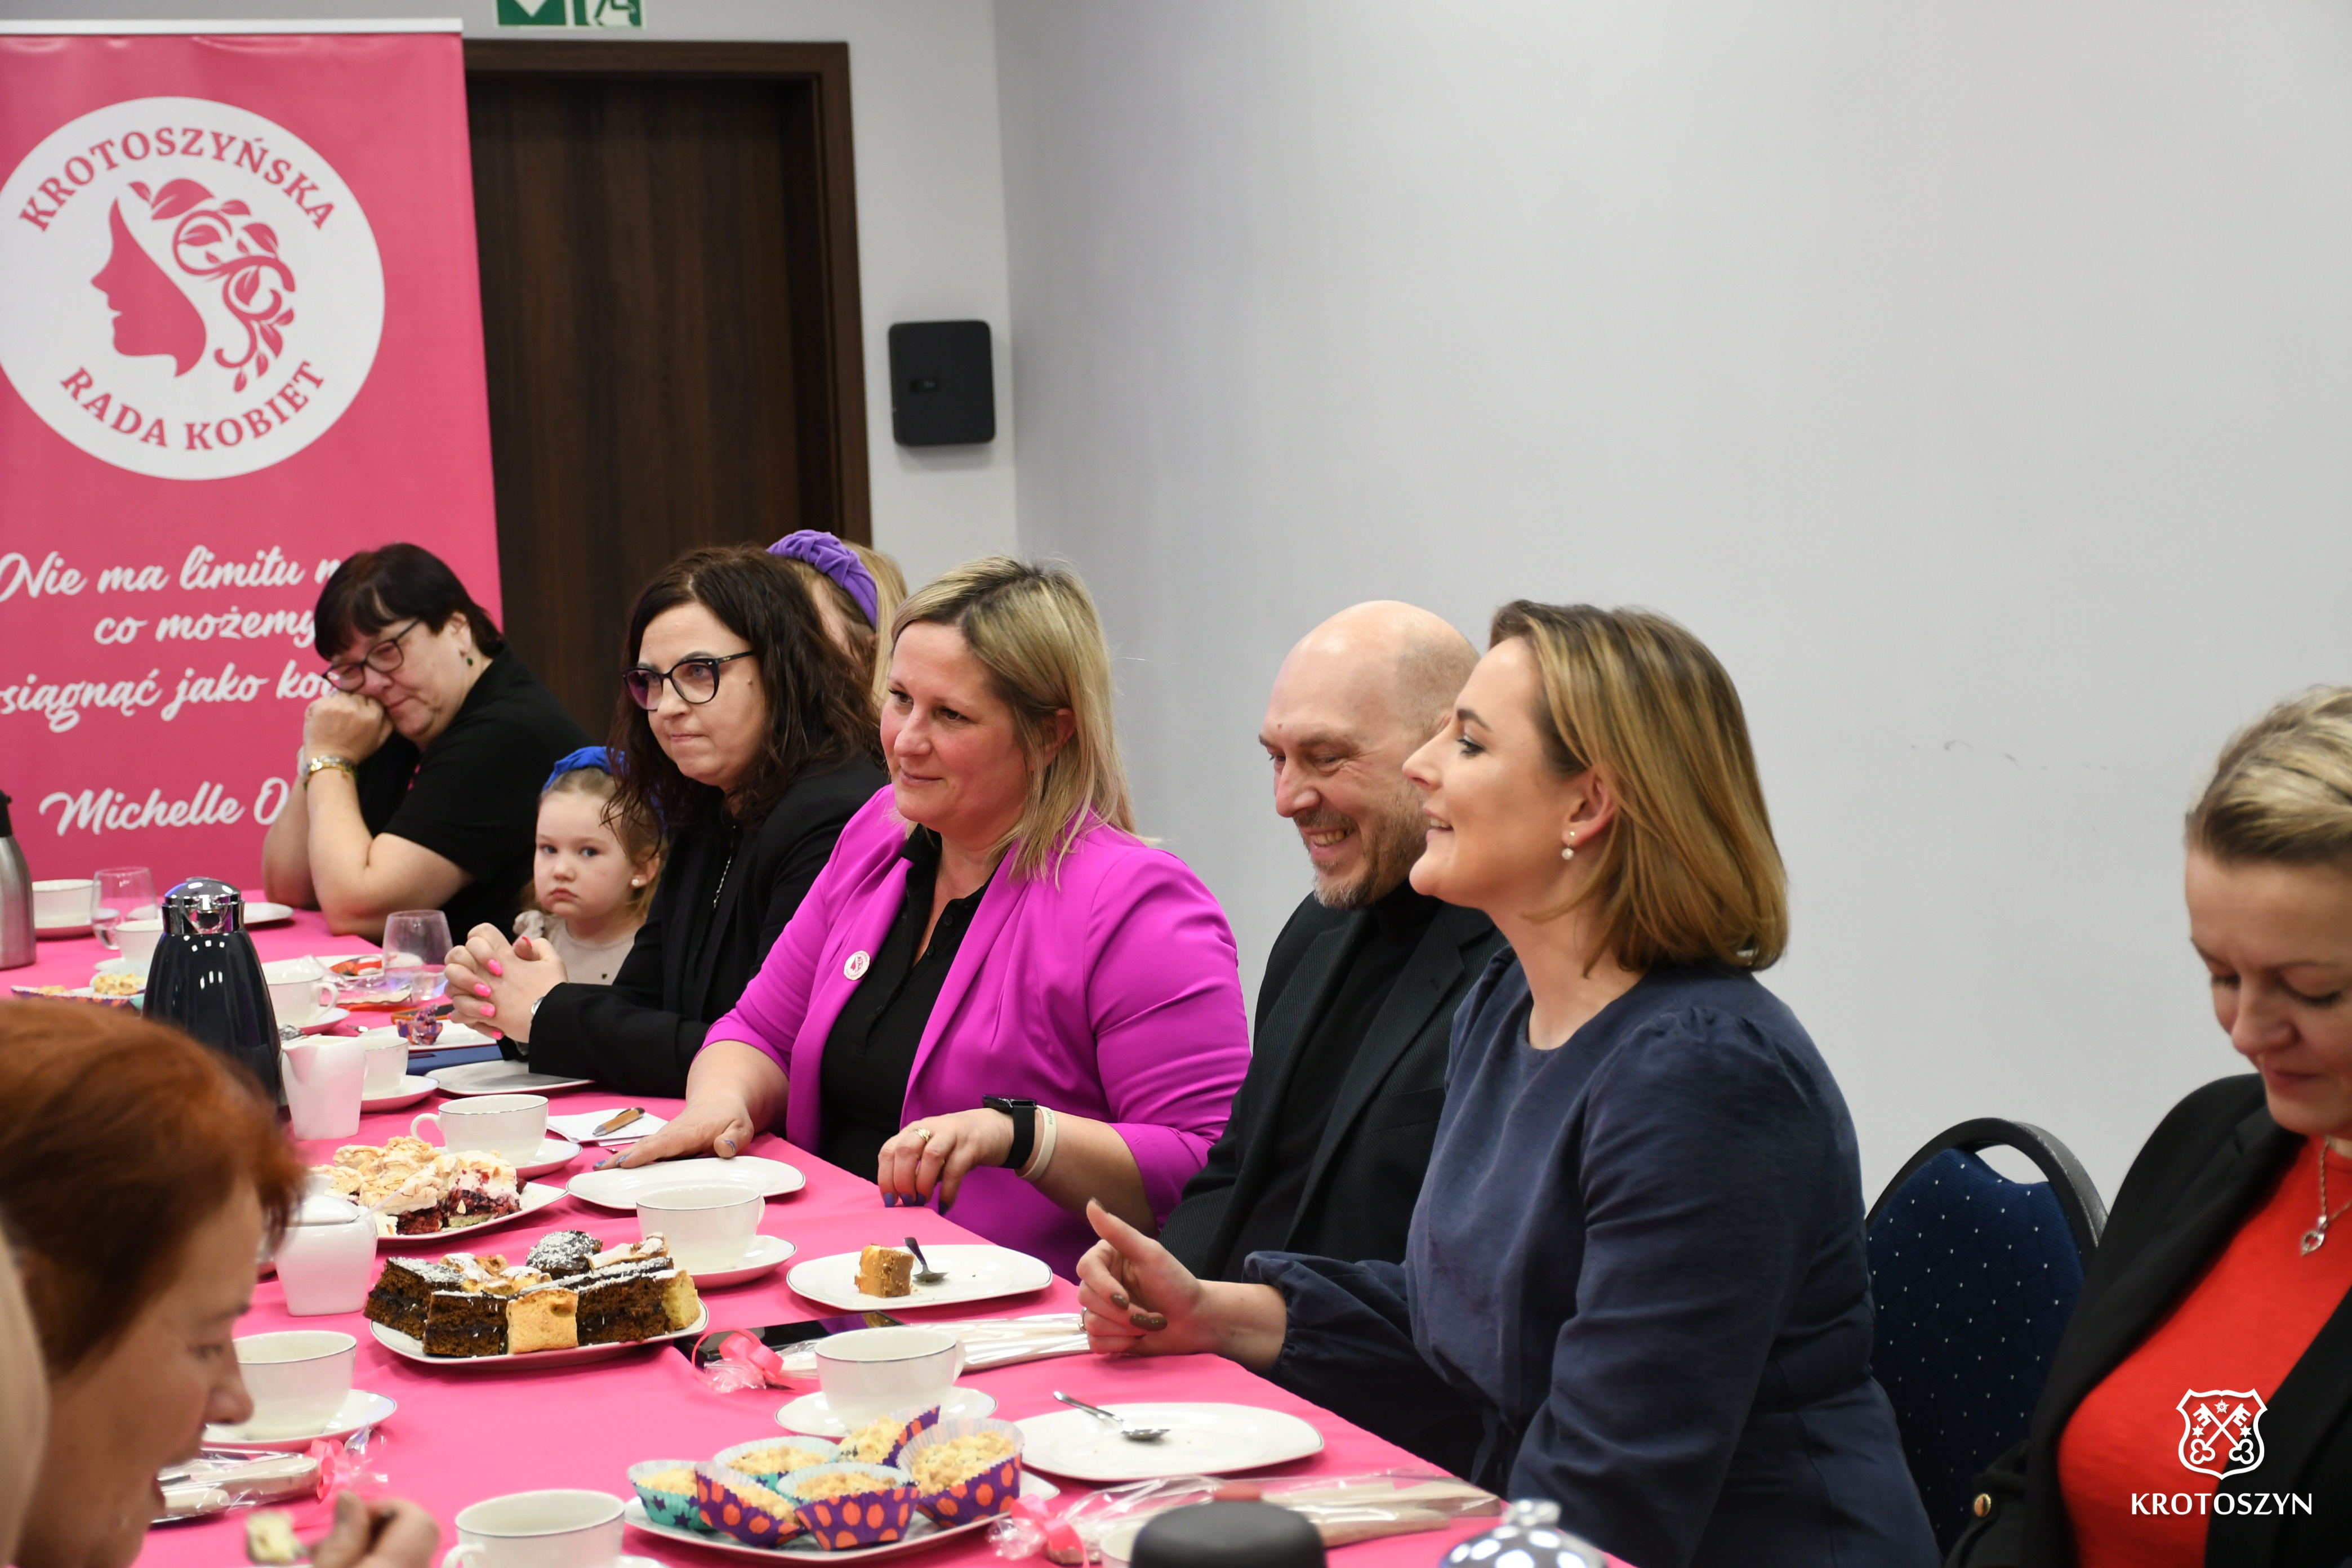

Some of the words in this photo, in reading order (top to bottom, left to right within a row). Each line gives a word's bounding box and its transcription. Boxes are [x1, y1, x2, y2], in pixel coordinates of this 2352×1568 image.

[19, 127, 335, 232] KROTOSZYŃSKA
[60, 367, 168, 448] RADA
[184, 360, 324, 450] KOBIET
[0, 550, 88, 603] Nie
[97, 565, 171, 594] ma
[179, 544, 306, 590] limitu
[93, 616, 148, 645] co
[155, 604, 315, 648] możemy
[0, 667, 163, 733] siągnąć
[160, 661, 270, 721] jako
[38, 781, 246, 836] Michelle
